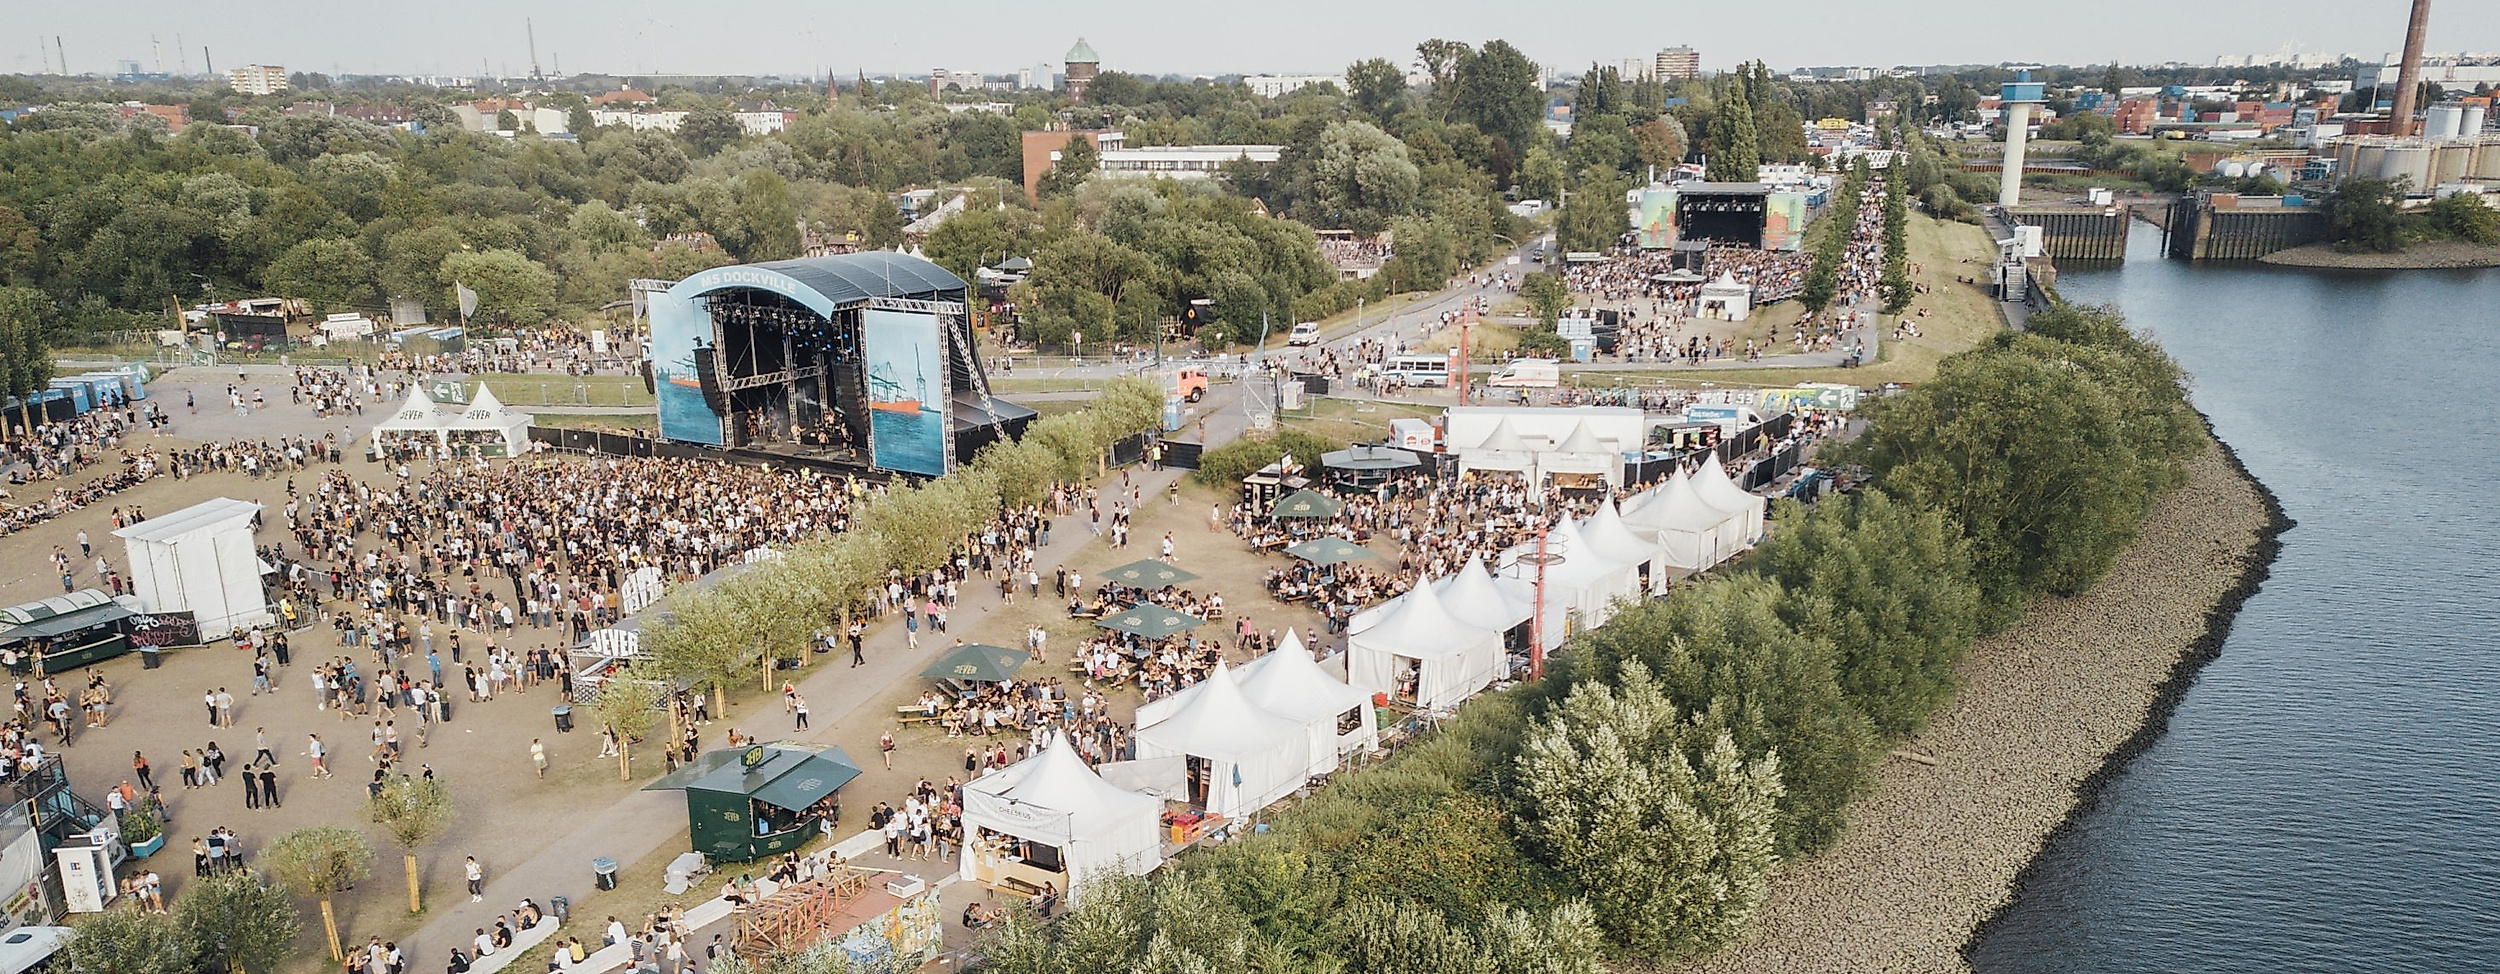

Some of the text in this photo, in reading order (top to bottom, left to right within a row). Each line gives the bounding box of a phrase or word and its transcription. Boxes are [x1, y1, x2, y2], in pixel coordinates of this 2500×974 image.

[702, 272, 796, 294] MS DOCKVILLE
[400, 409, 424, 420] JEVER
[467, 409, 491, 420] JEVER
[590, 629, 639, 656] JEVER
[954, 664, 978, 675] JEVER
[746, 747, 762, 766] JEVER
[723, 811, 740, 822] JEVER
